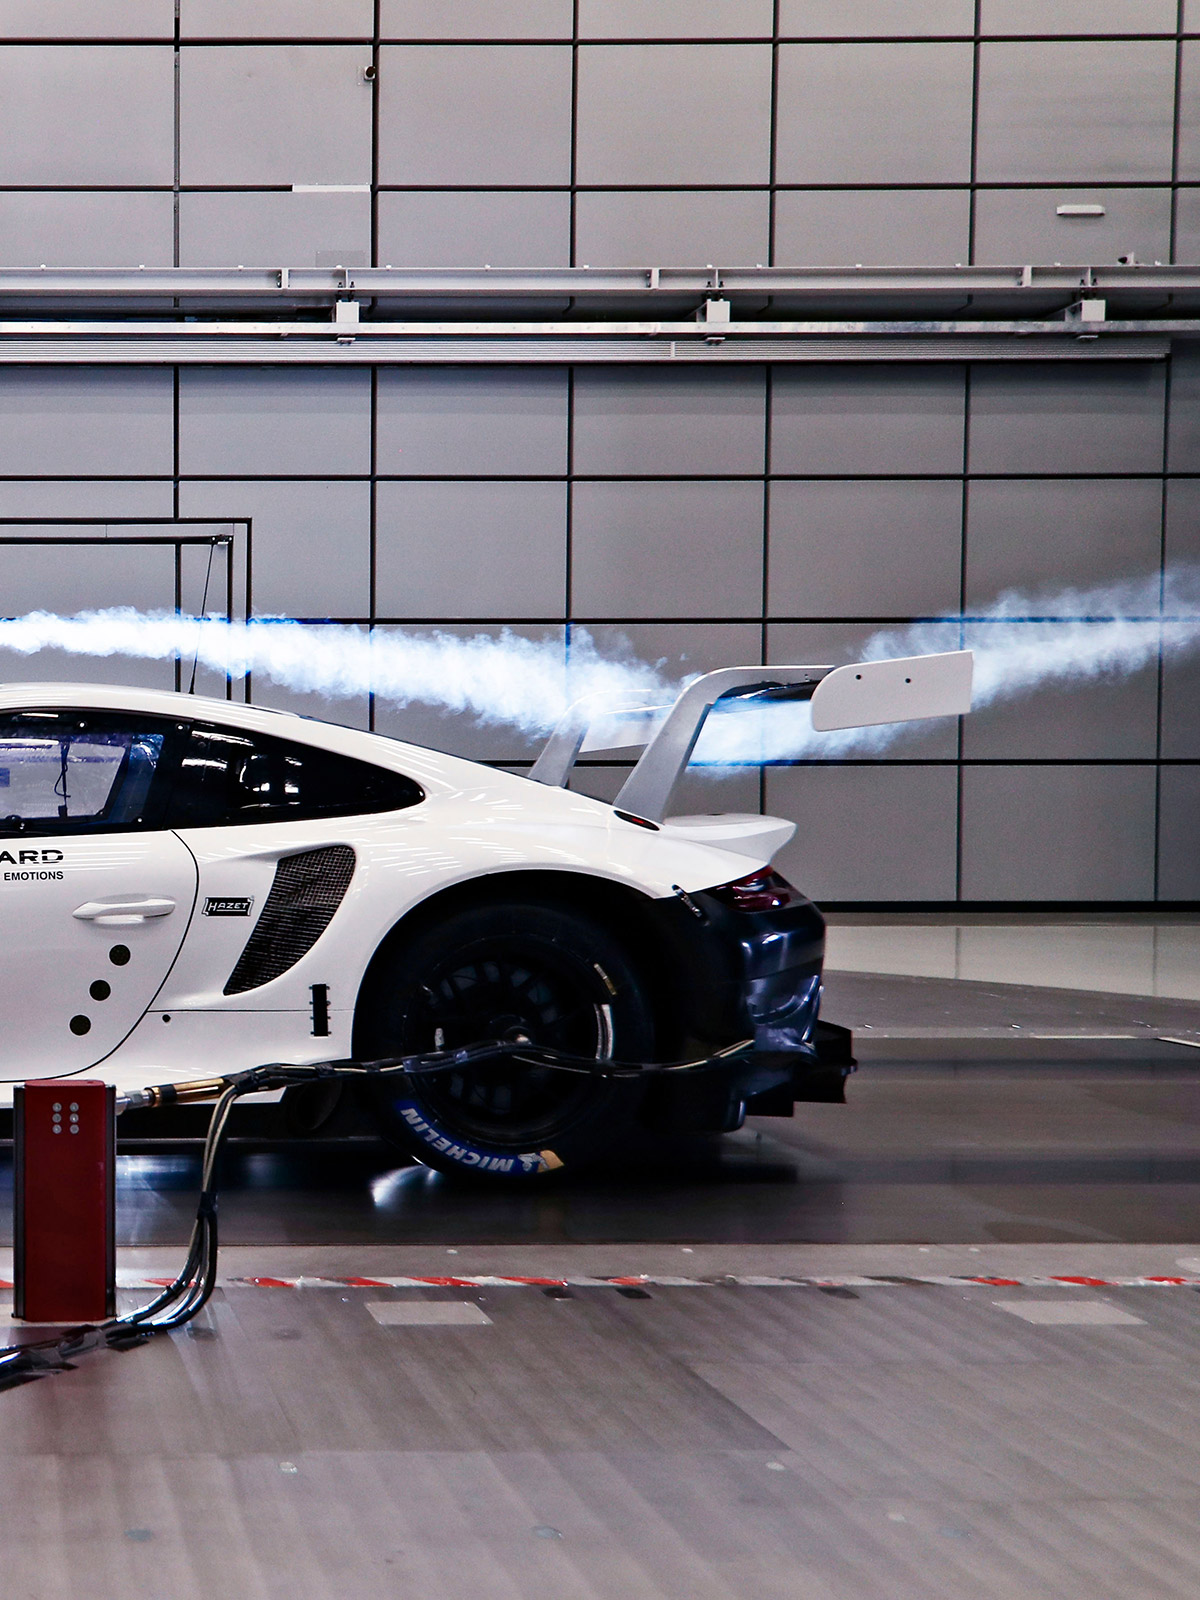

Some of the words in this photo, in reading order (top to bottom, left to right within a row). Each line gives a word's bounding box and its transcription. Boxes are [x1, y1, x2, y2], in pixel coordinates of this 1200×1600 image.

[4, 871, 64, 881] EMOTIONS
[208, 902, 248, 911] HAZET
[400, 1107, 515, 1172] MICHELIN
